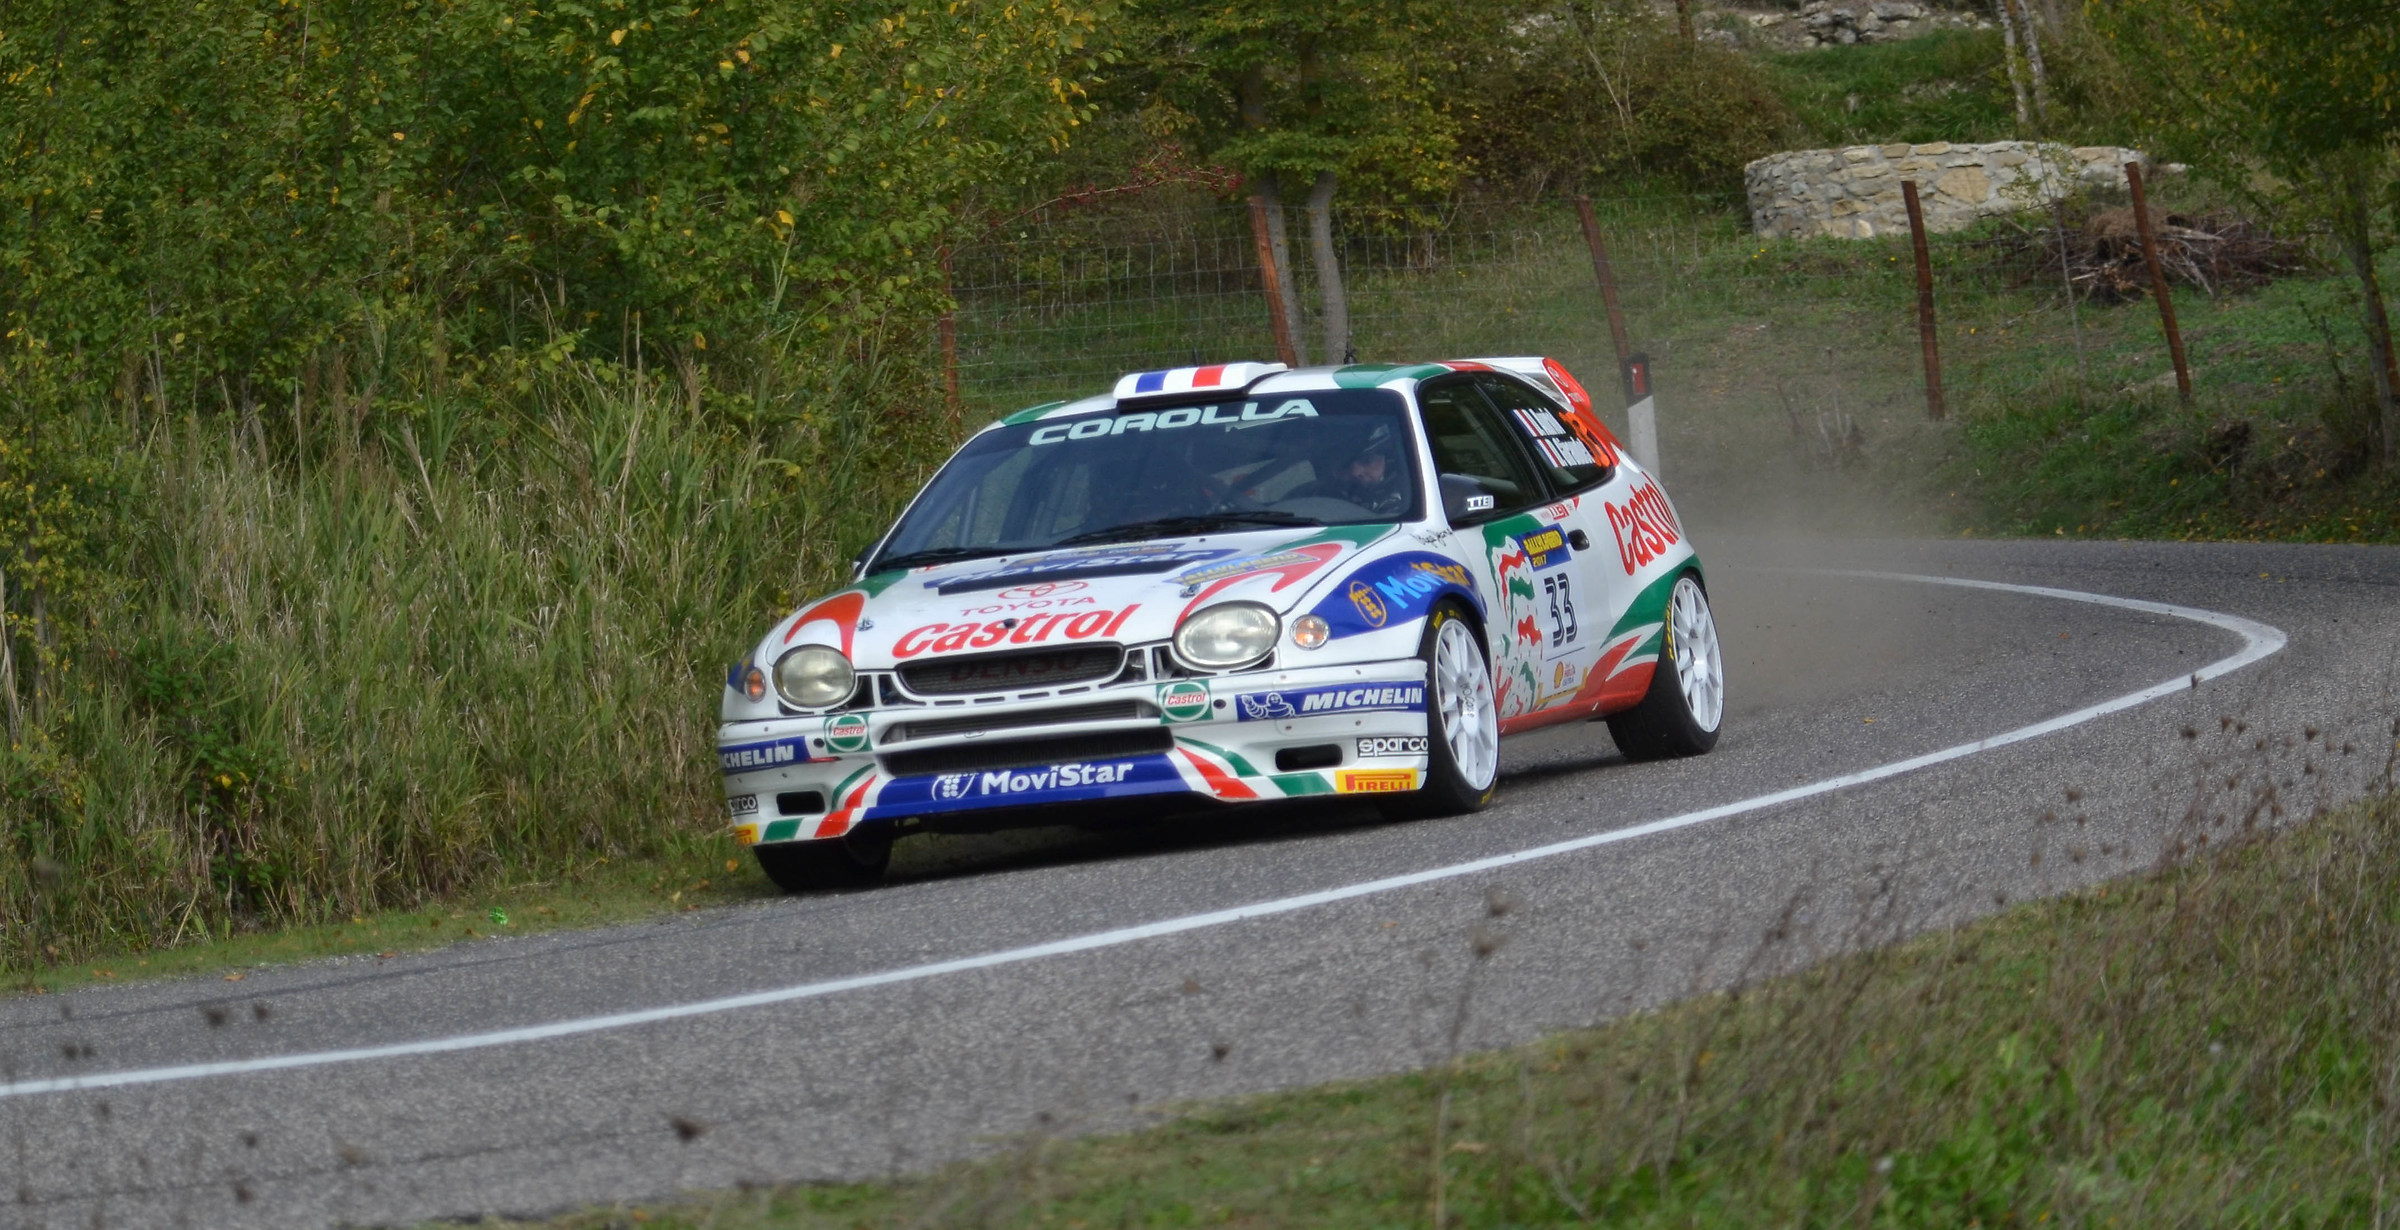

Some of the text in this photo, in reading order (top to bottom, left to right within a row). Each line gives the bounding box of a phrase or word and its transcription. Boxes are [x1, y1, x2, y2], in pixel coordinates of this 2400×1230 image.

[1029, 399, 1319, 446] COROLLA
[1604, 471, 1680, 576] Castrol
[1532, 554, 1547, 568] 2017
[1375, 562, 1471, 609] MoviStar
[961, 596, 1096, 616] TOYOTA
[1544, 572, 1577, 648] 33
[891, 603, 1142, 659] Castrol
[1167, 692, 1206, 706] Castrol
[1302, 687, 1423, 711] MICHELIN
[833, 724, 866, 737] Castrol
[1358, 737, 1428, 757] sparco
[981, 763, 1135, 795] MoviStar
[1345, 773, 1412, 792] PIRELLI
